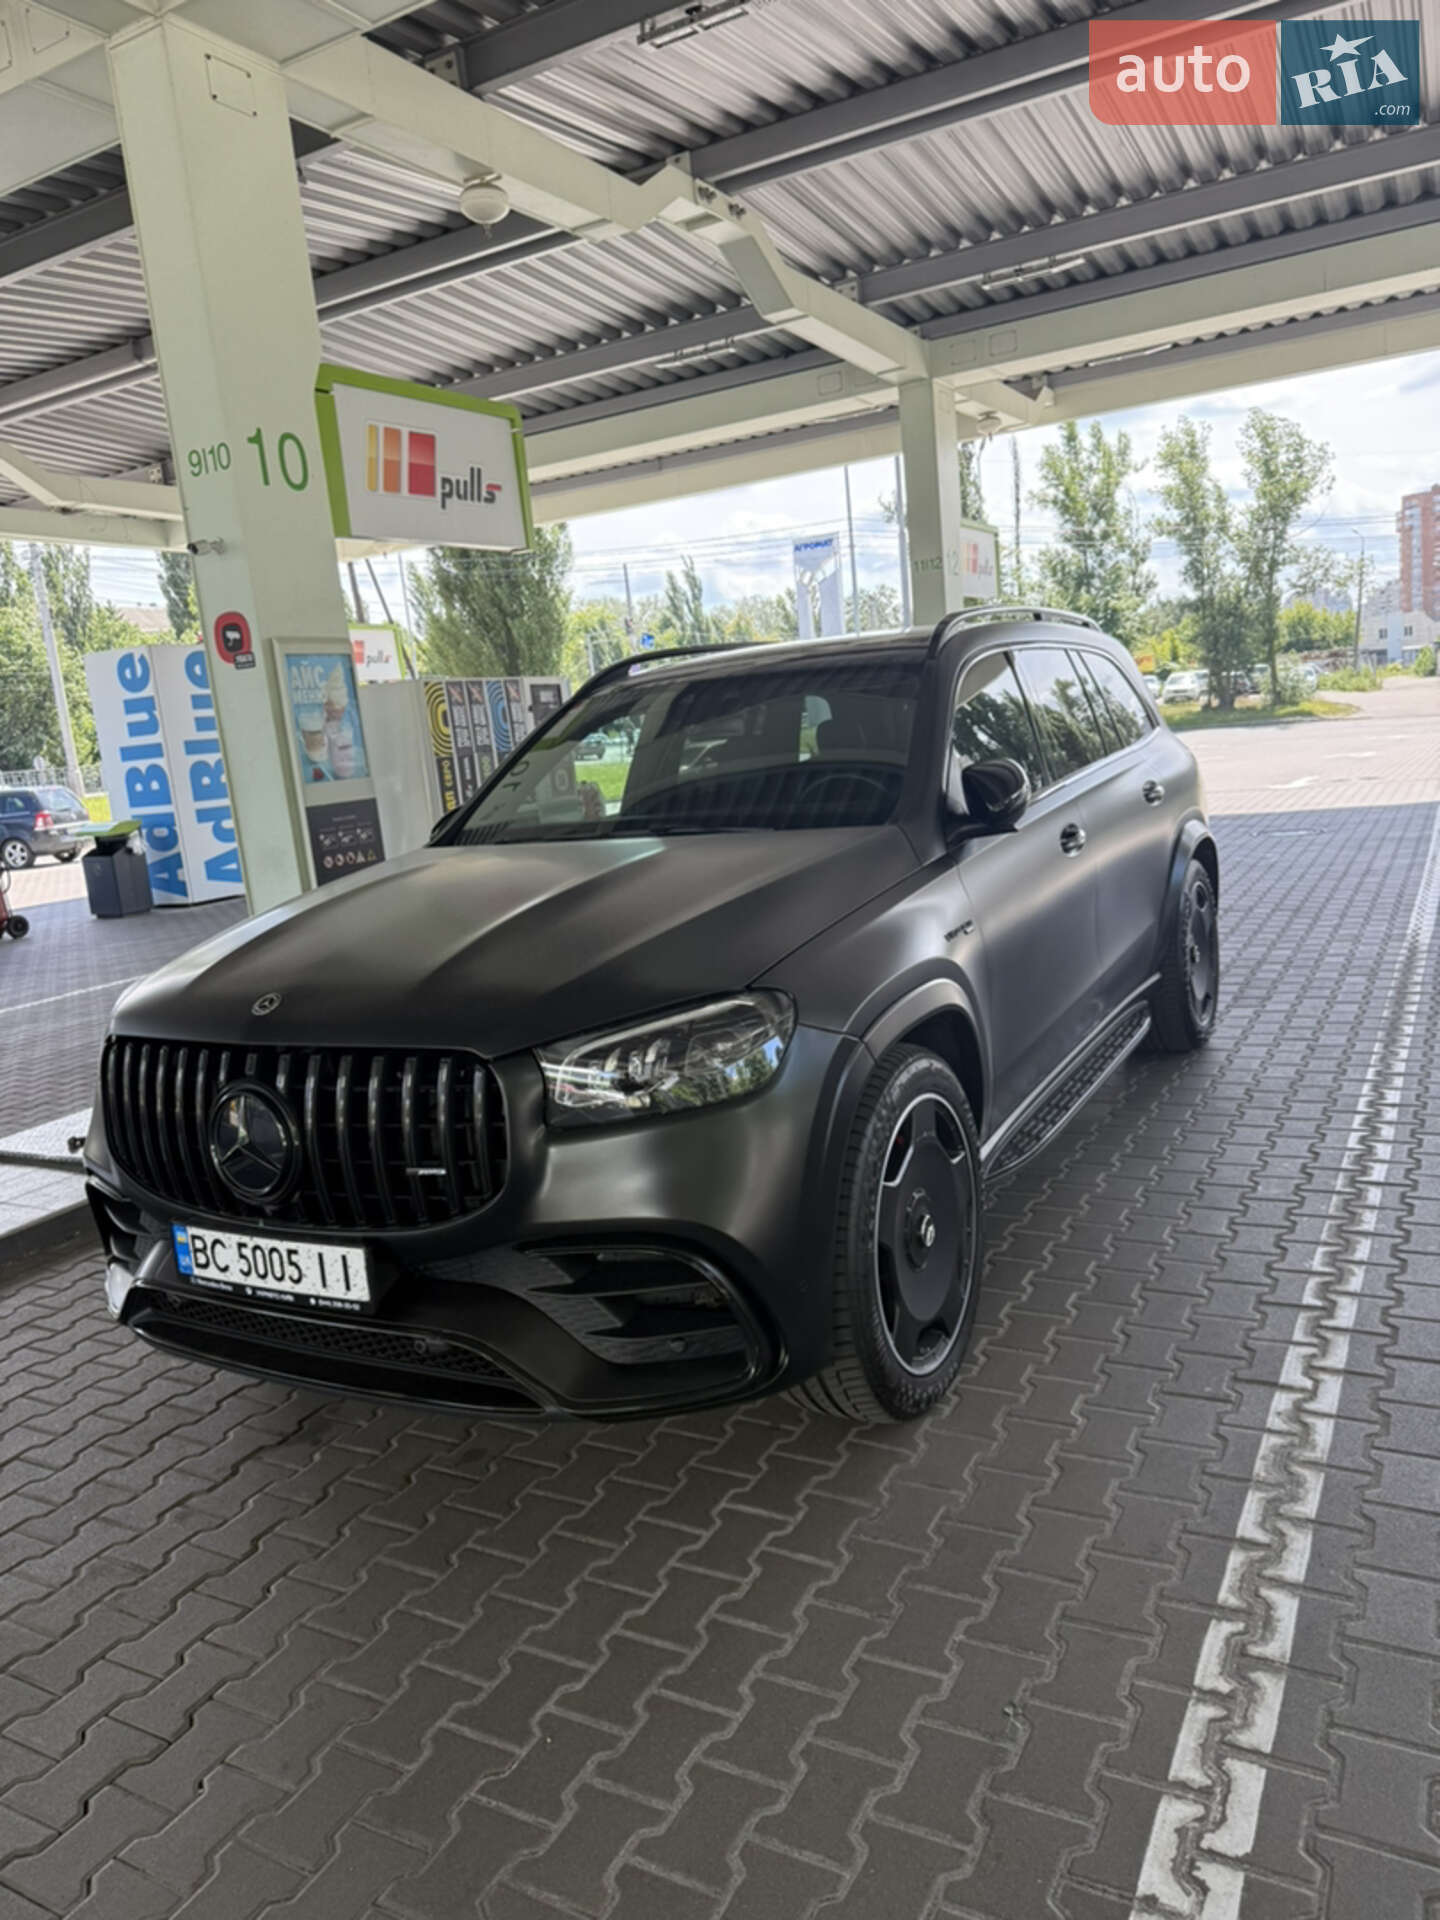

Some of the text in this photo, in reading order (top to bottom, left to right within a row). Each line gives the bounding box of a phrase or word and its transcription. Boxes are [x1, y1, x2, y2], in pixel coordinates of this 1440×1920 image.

[246, 427, 309, 491] 10
[440, 466, 502, 510] pulls
[117, 652, 189, 897] AdBlue
[190, 1234, 230, 1274] BC
[236, 1241, 304, 1285] 5005
